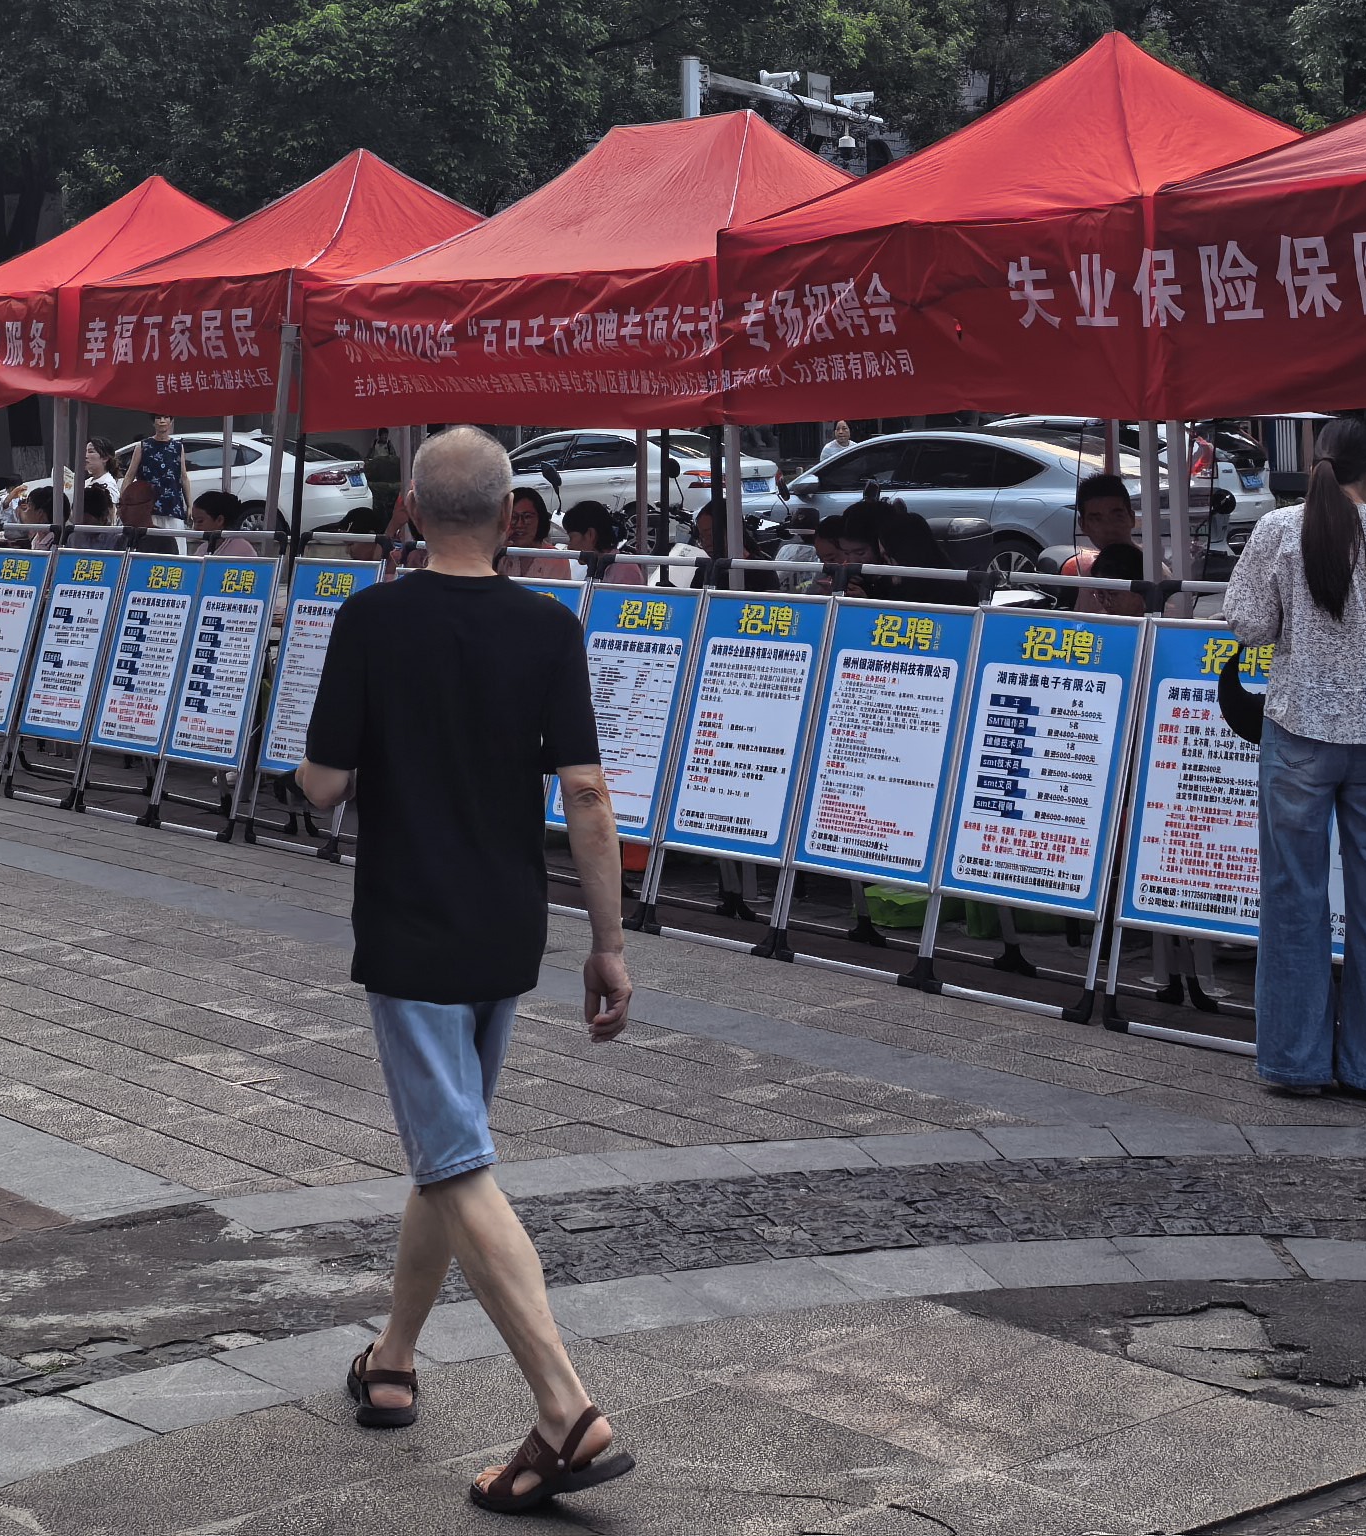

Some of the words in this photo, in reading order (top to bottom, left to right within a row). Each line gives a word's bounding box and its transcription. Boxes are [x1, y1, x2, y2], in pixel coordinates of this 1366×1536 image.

[0, 558, 31, 581] 招聘
[72, 559, 106, 581] 招聘
[147, 565, 183, 590] 招聘
[221, 568, 257, 594] 招聘
[315, 571, 354, 598] 招聘
[616, 599, 668, 631] 招聘
[737, 603, 793, 636] 招聘
[871, 613, 934, 651] 招聘
[1021, 625, 1095, 665] 招聘
[1200, 638, 1275, 677] 招聘
[997, 671, 1106, 695] 湖南谐振电子有限公司
[1168, 686, 1219, 703] 湖南福瑞
